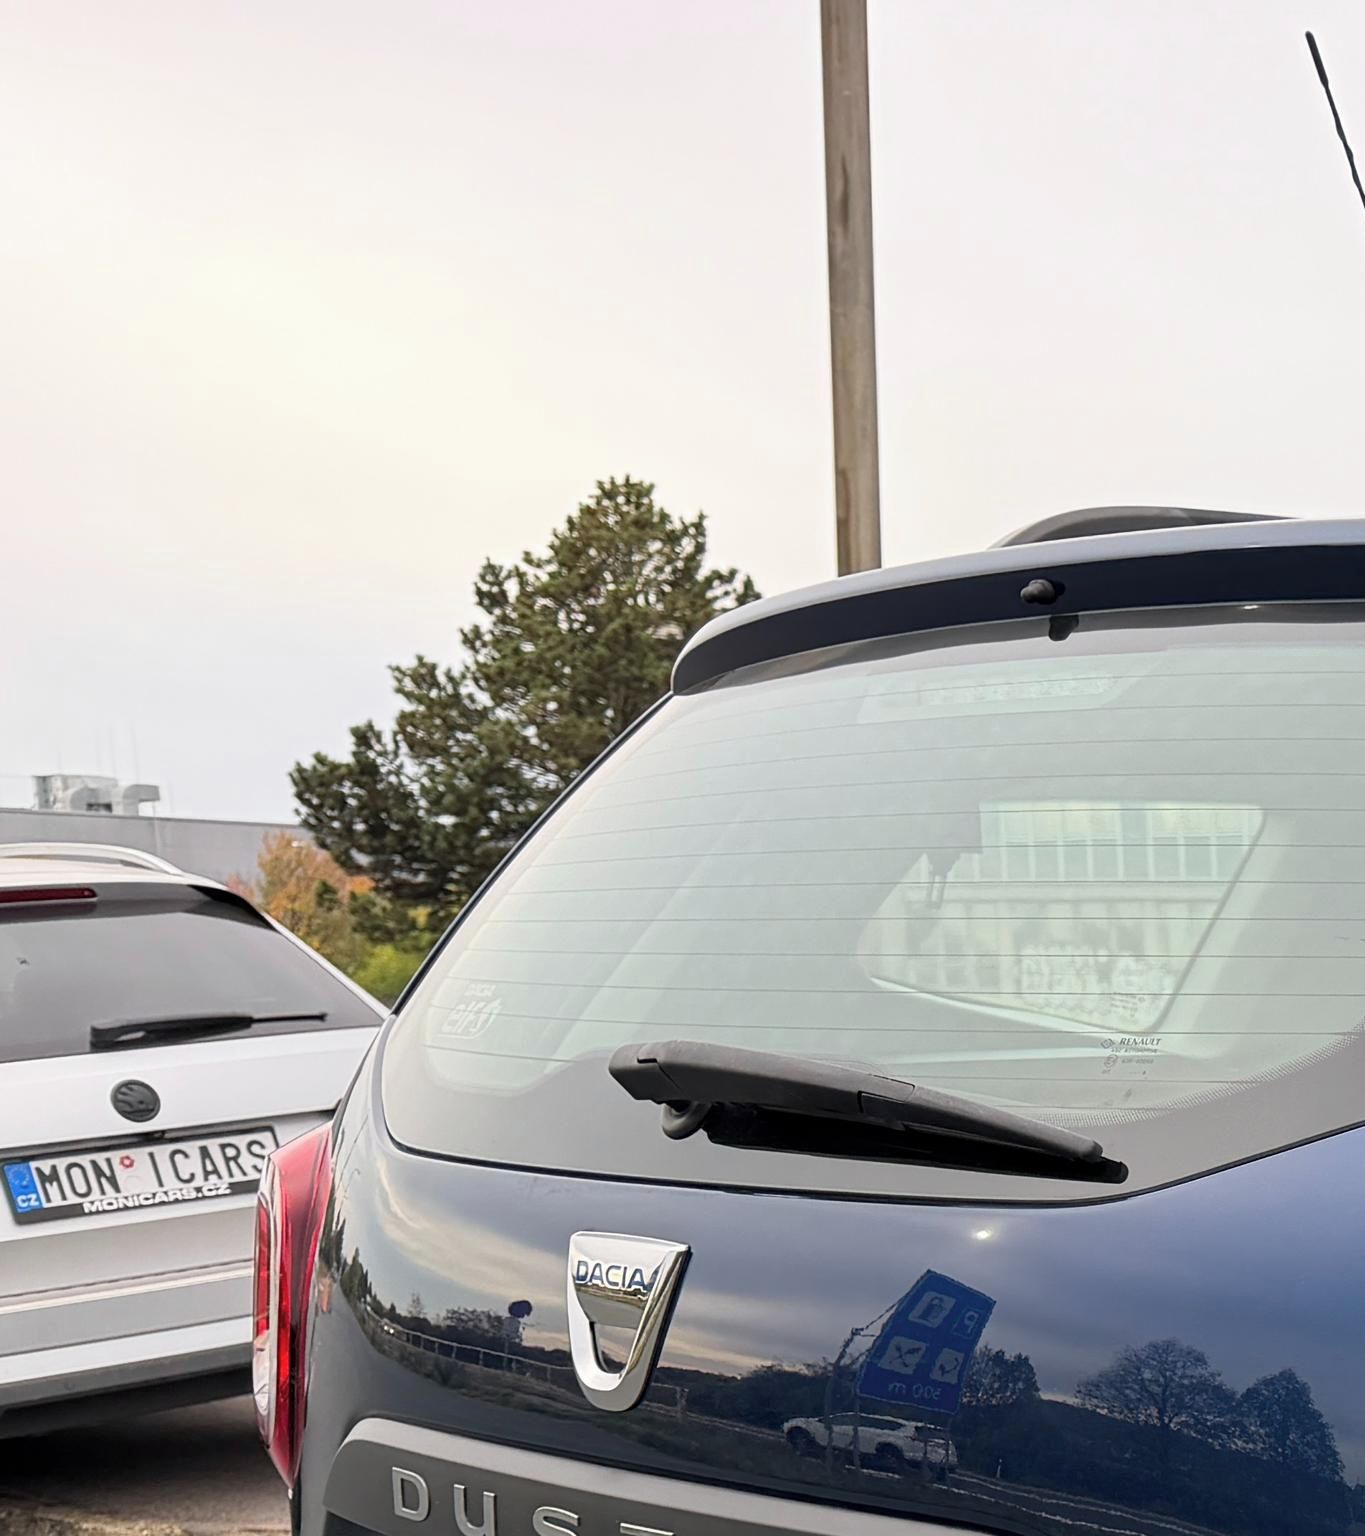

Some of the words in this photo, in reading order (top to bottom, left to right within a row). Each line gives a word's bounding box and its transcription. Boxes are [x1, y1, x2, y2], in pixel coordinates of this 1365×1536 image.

[34, 1156, 121, 1204] MON
[16, 1192, 39, 1208] CZ
[82, 1181, 232, 1214] MONICARS.CZ
[575, 1259, 648, 1291] DACIA
